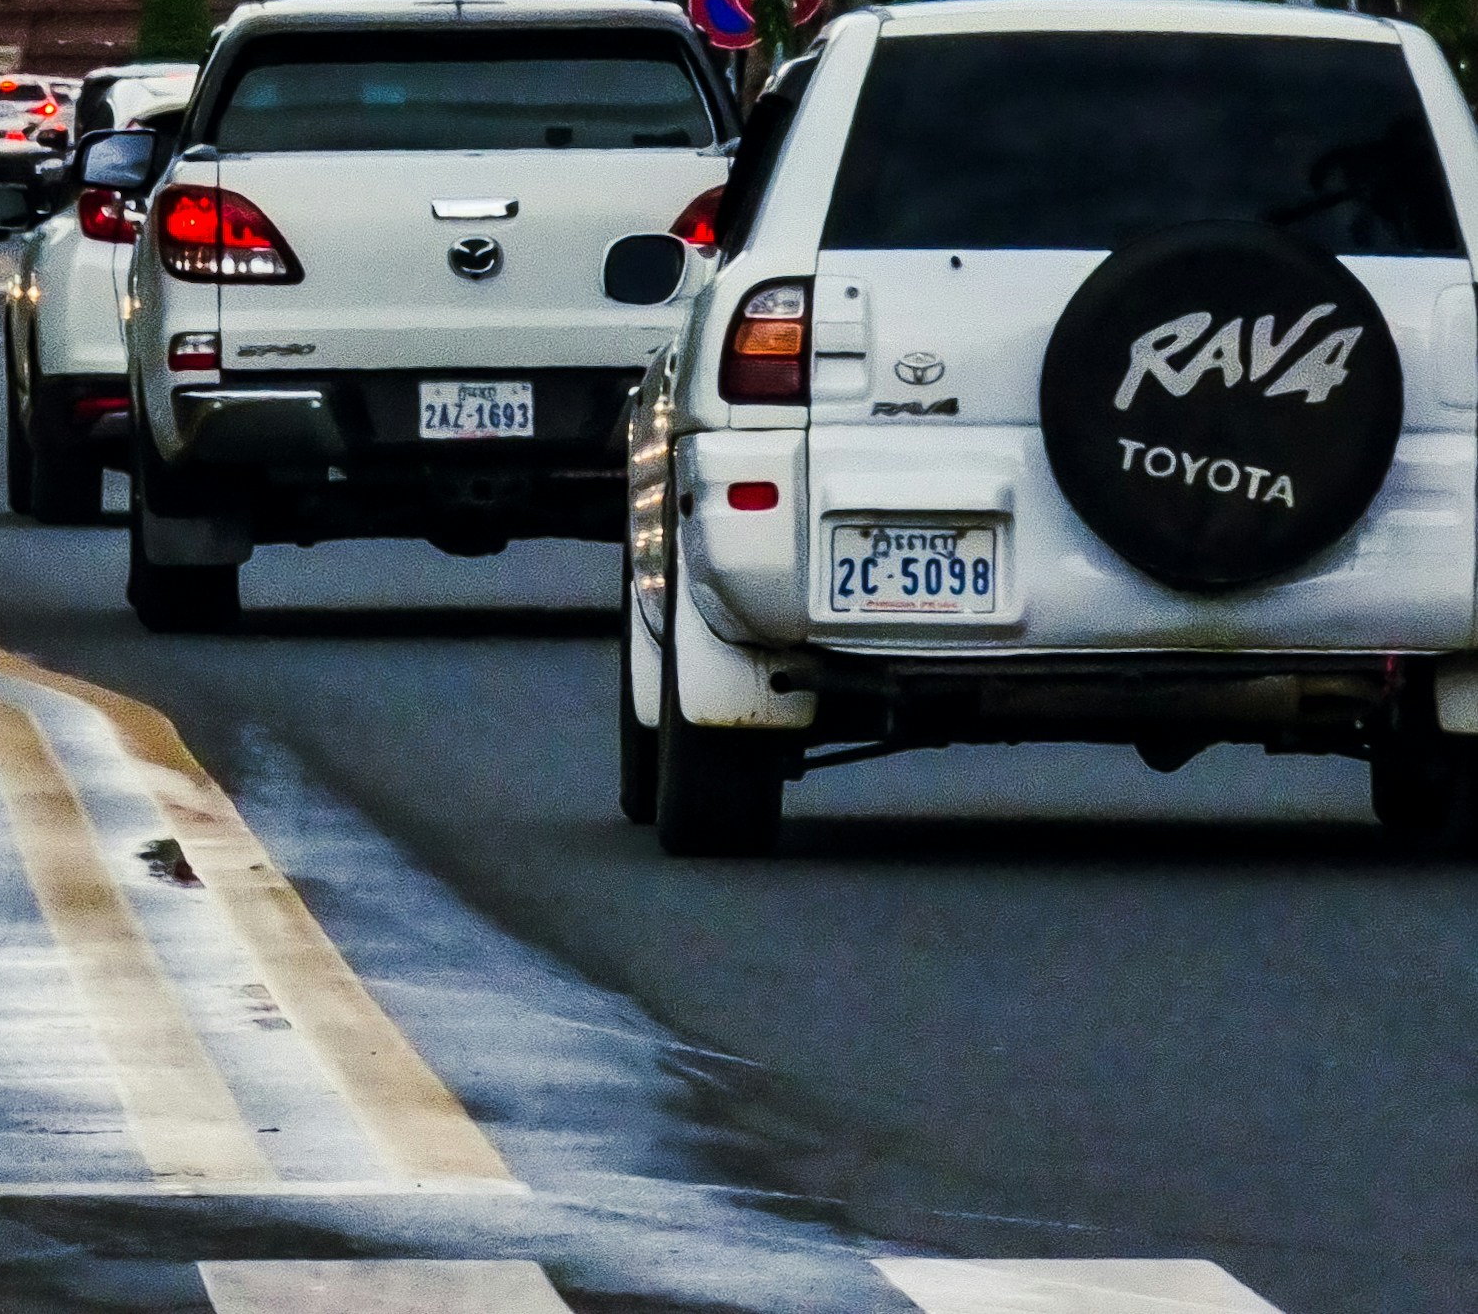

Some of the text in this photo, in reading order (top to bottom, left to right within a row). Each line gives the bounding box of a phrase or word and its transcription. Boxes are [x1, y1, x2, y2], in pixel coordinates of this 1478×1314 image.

[1114, 302, 1363, 411] RAV4
[425, 402, 529, 429] 2AZ-1693
[1118, 437, 1295, 509] TOYOTA
